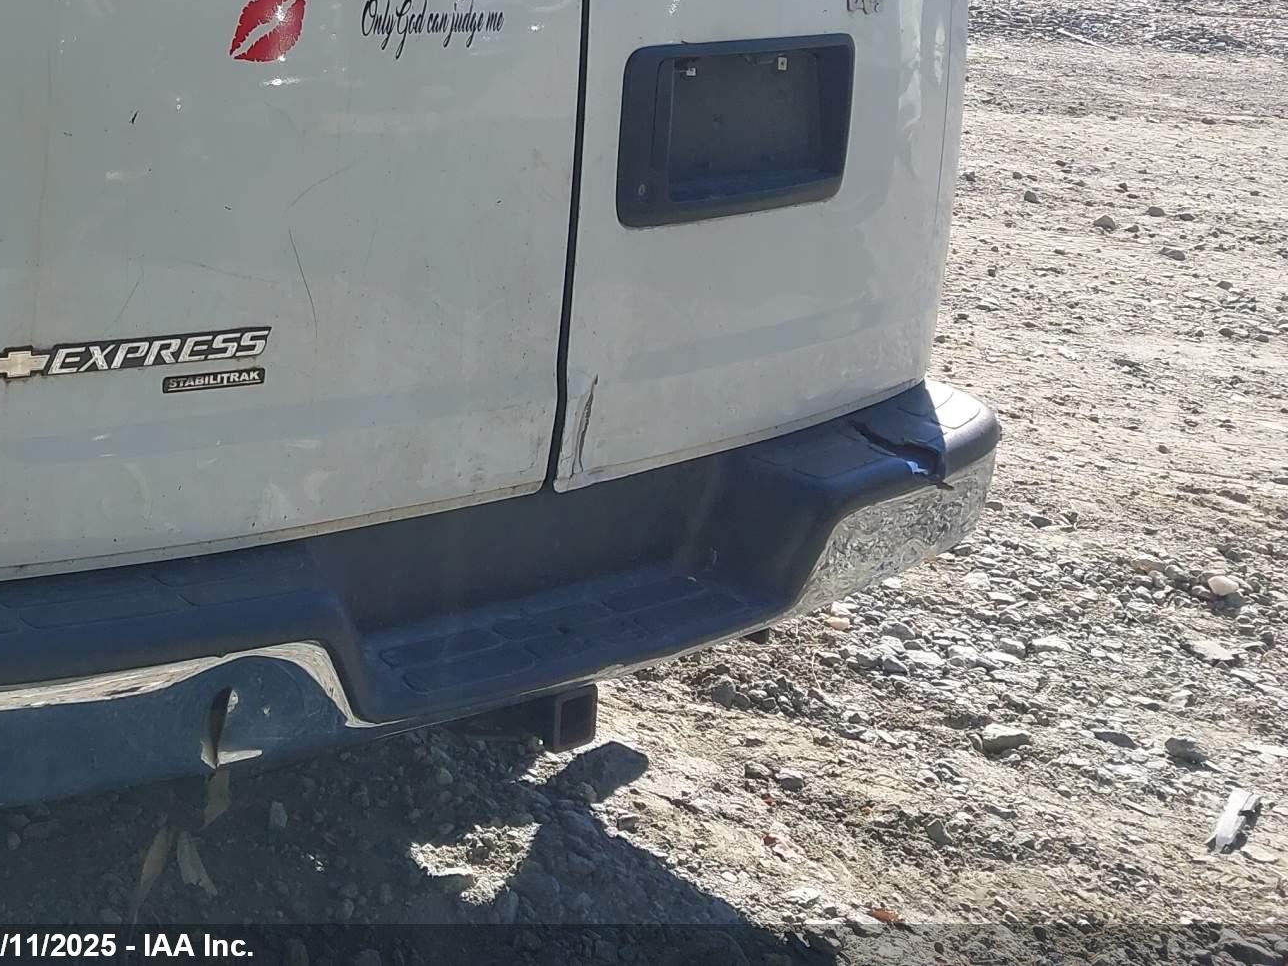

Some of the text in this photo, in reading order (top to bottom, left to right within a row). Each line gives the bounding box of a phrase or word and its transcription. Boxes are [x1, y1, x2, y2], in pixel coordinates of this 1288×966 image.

[427, 12, 449, 34] can
[486, 11, 505, 32] me
[47, 330, 269, 375] EXPRESS
[167, 369, 261, 389] STABILITRAK
